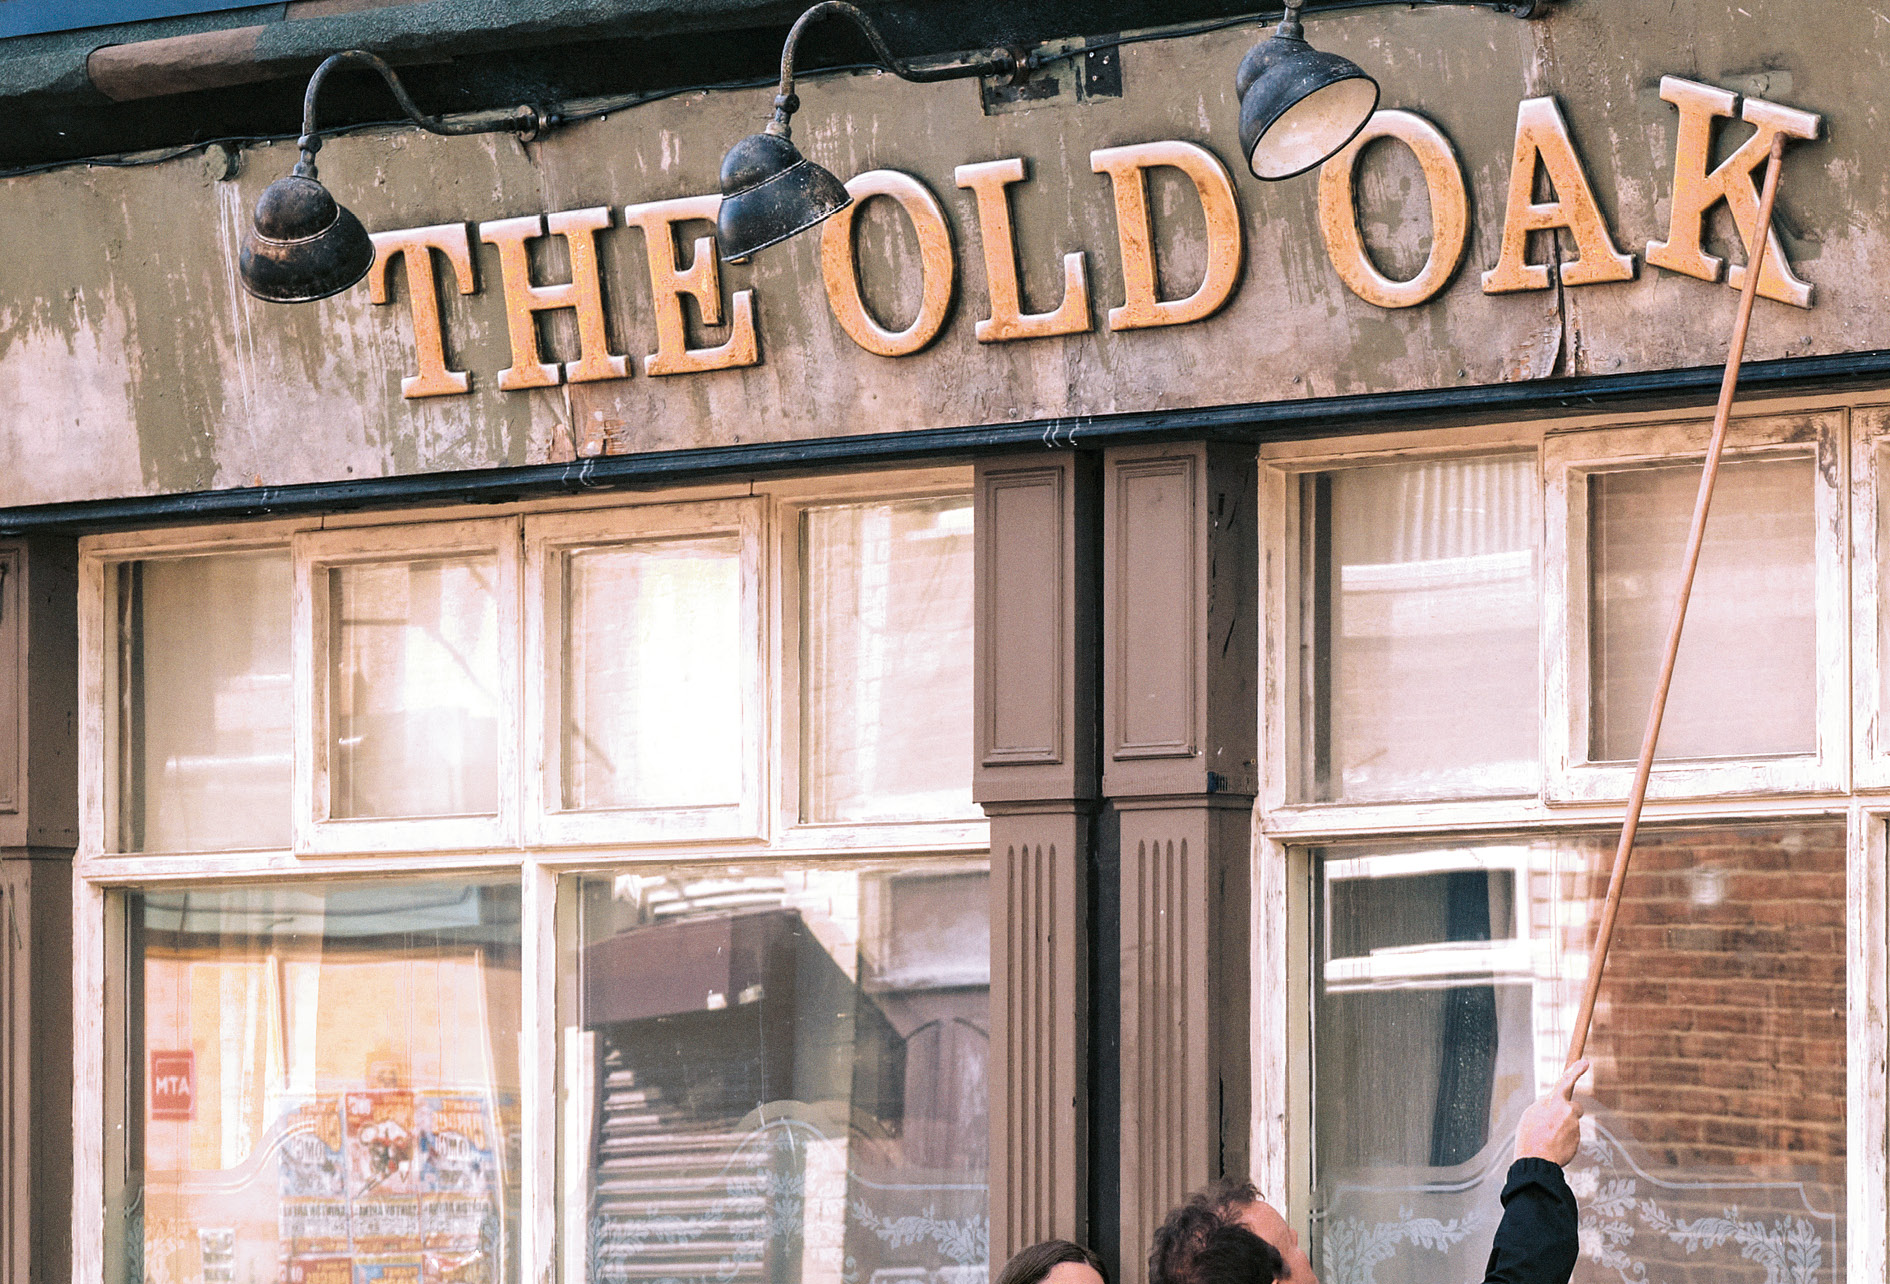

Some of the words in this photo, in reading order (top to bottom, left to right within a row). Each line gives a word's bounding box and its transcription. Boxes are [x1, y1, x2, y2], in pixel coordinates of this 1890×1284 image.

[369, 195, 760, 399] THE
[820, 140, 1243, 358] OLD
[1318, 73, 1822, 310] OAK
